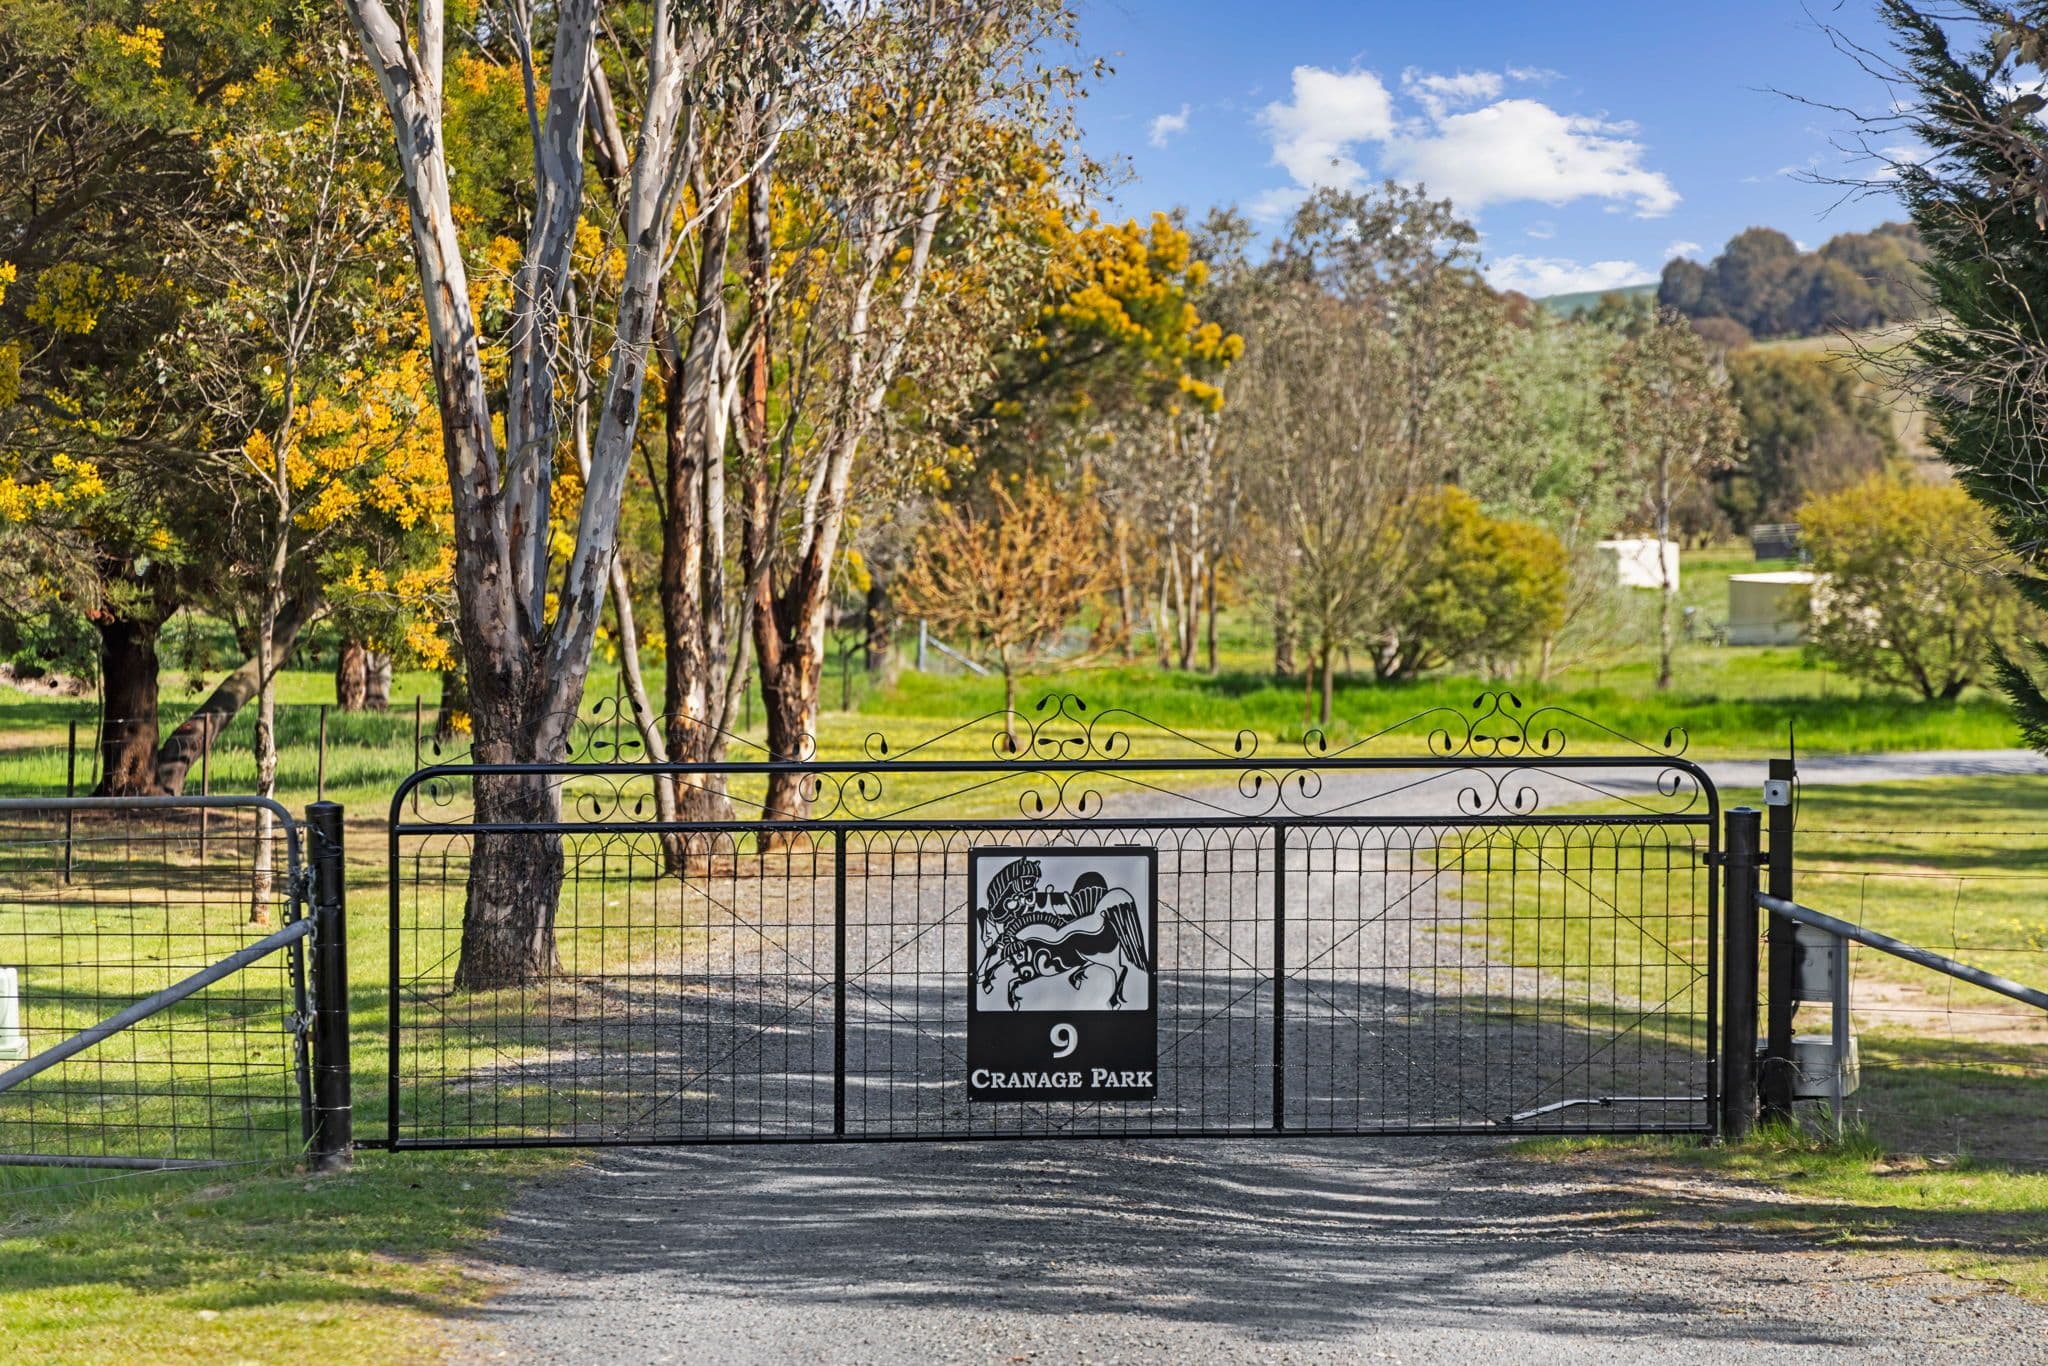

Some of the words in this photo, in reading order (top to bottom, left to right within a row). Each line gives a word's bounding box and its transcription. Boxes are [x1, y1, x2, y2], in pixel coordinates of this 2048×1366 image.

[1050, 1023, 1078, 1058] 9
[971, 1068, 1082, 1089] CRANAGE
[1091, 1068, 1153, 1088] PARK
